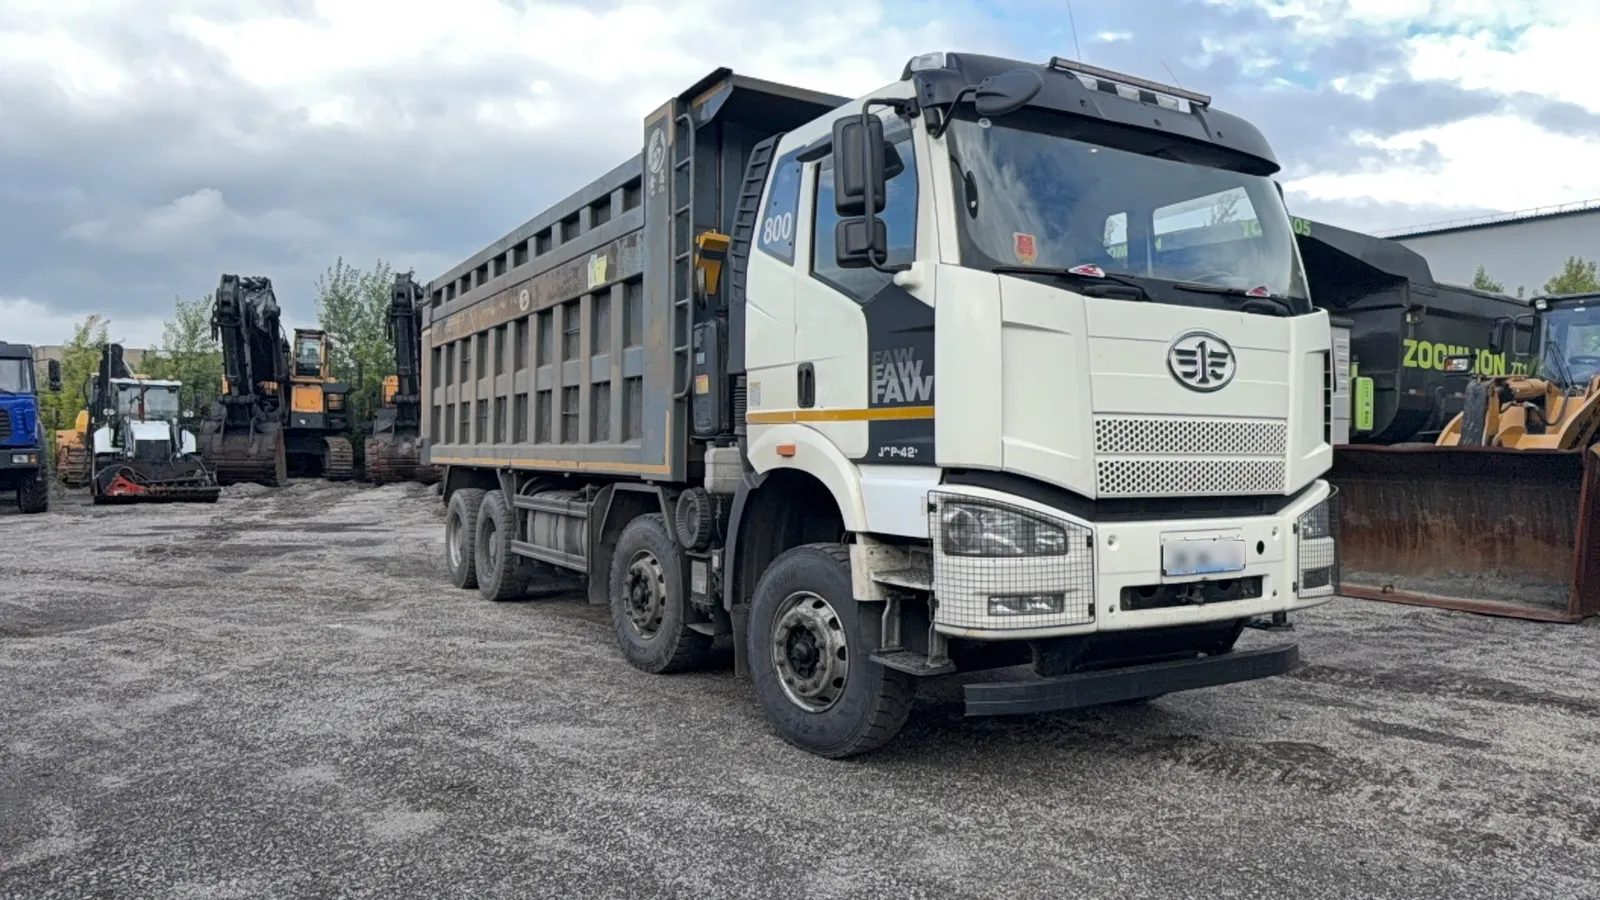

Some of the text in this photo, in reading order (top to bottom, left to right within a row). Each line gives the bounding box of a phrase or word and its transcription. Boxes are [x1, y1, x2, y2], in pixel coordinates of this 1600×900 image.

[763, 211, 792, 245] 800
[872, 359, 924, 381] FAW
[872, 375, 934, 404] FAW
[877, 446, 918, 458] JP-42
